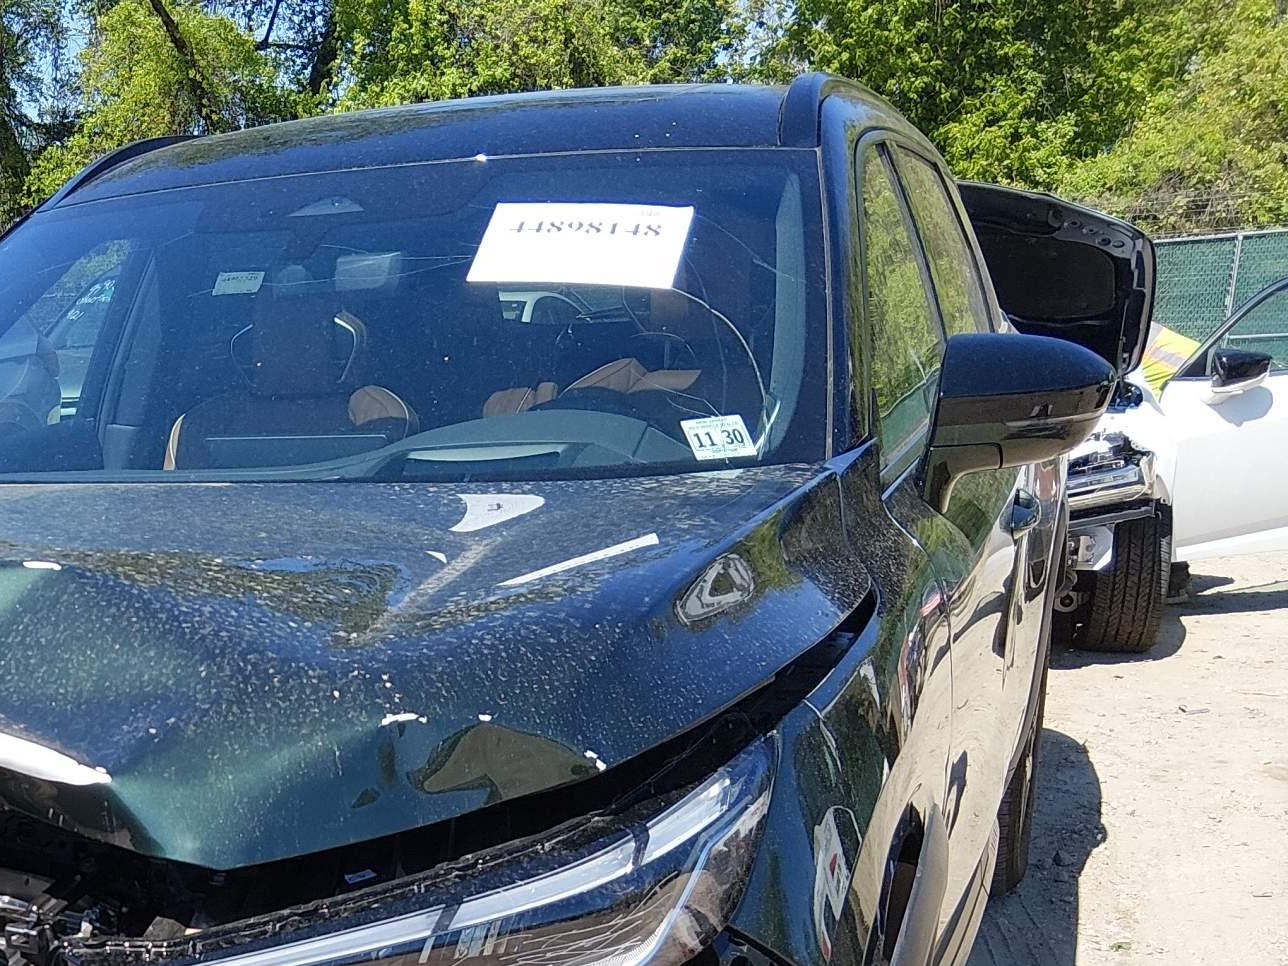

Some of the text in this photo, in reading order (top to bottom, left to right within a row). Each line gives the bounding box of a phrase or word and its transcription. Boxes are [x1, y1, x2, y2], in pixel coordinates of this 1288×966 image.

[510, 220, 662, 237] 44898148
[693, 428, 745, 448] 11 30
